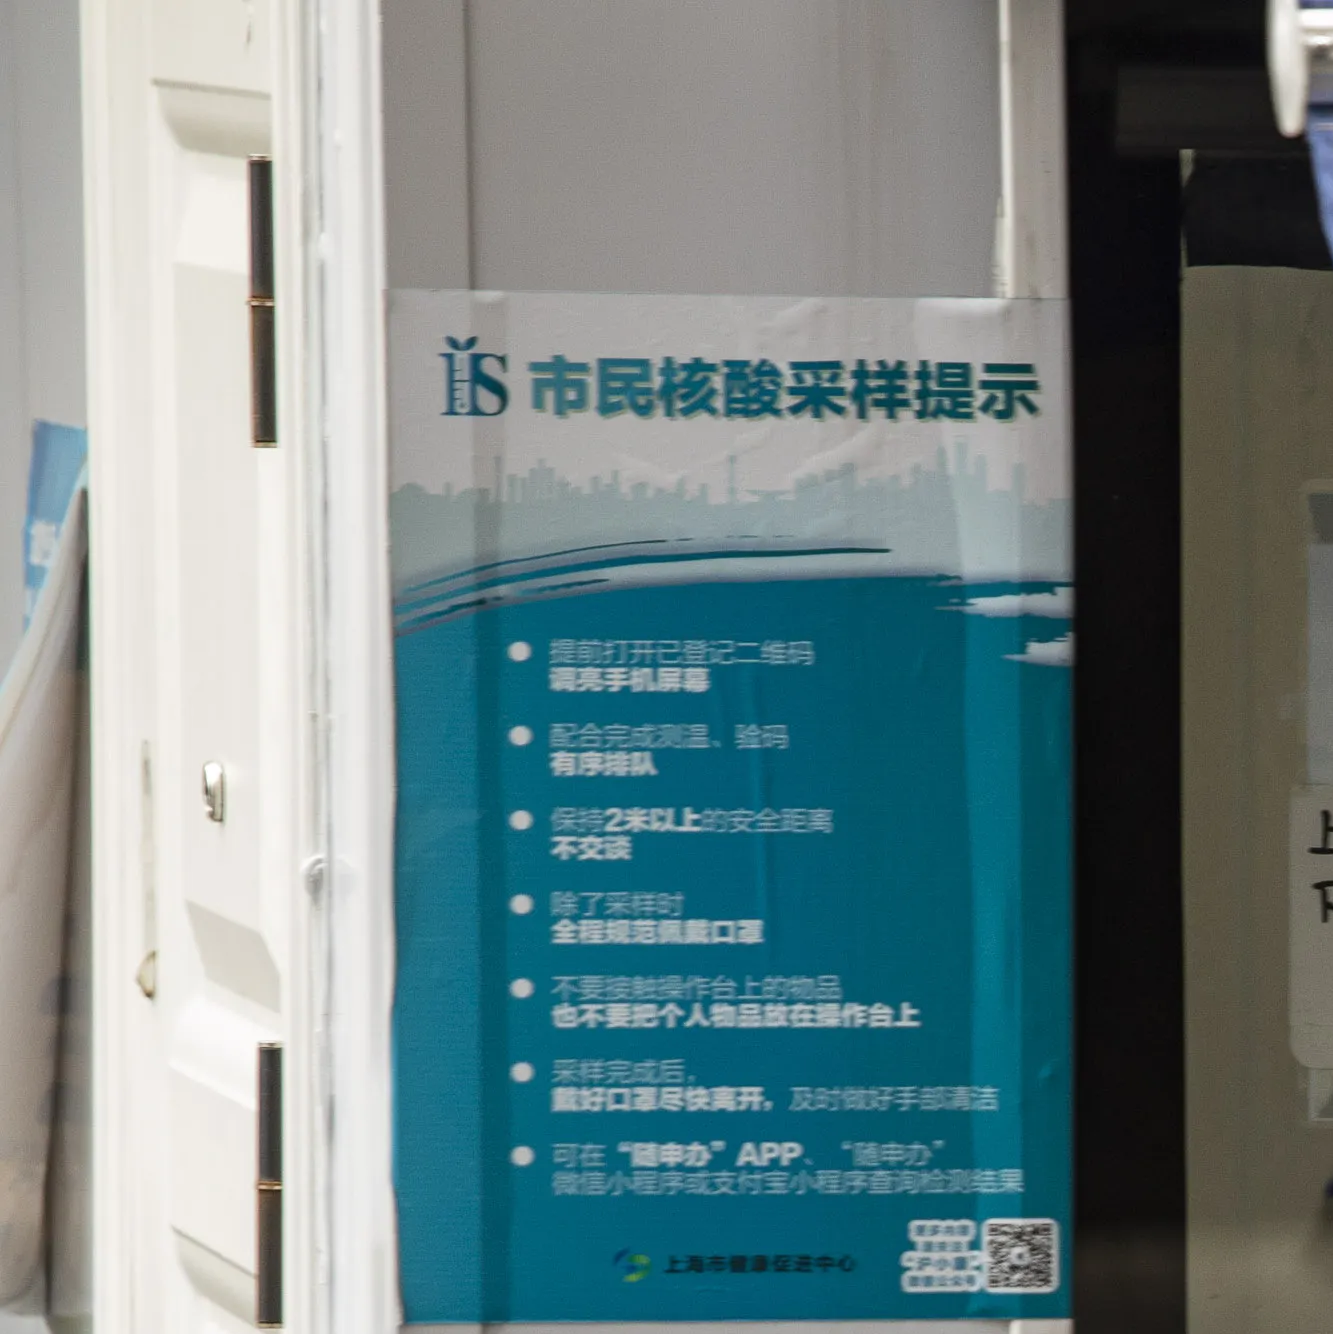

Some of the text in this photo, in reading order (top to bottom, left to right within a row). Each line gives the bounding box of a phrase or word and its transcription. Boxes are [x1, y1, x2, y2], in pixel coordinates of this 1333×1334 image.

[528, 355, 1042, 421] 市民核酸采样提示
[549, 668, 711, 692] 调亮手机屏幕
[550, 751, 658, 776] 有序排队
[550, 808, 834, 833] 保持2米以上的安全距离
[550, 836, 633, 860] 不交谈
[550, 892, 684, 917] 除了采样时
[551, 1003, 921, 1028] 也不要把个人物品放在操作台上
